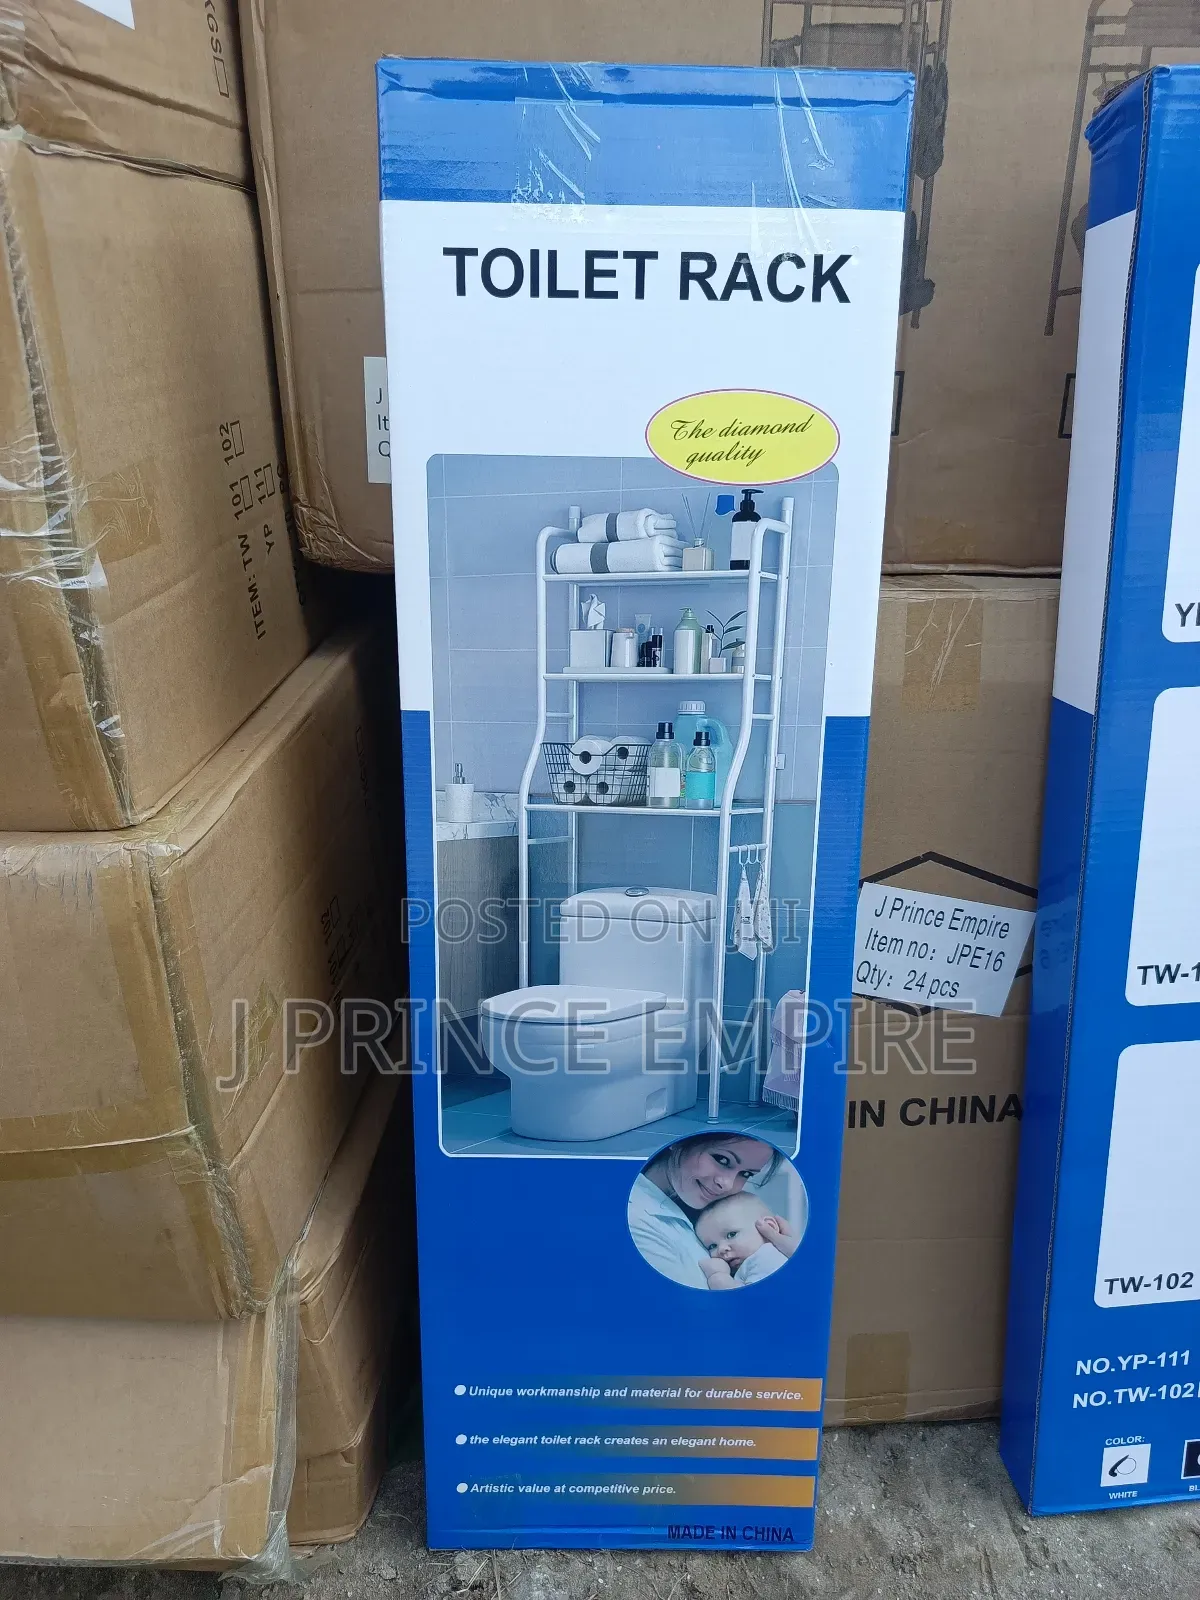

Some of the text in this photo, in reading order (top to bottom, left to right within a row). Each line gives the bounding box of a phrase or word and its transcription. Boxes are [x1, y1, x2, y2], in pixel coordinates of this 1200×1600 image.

[443, 247, 852, 303] TOILET RACK
[670, 414, 815, 442] The diamond
[685, 441, 766, 471] quality
[253, 466, 275, 556] YP 111
[219, 421, 267, 641] ITEM: TW 101 102
[874, 895, 1010, 941] J Prince Empire
[864, 927, 904, 956] Item
[946, 943, 1005, 972] JPE16
[856, 960, 960, 1000] Qty: 24 pcs
[848, 1094, 1024, 1129] IN CHINA
[1103, 1271, 1195, 1295] TW-102
[1075, 1349, 1190, 1376] NO.YP-111
[469, 1386, 804, 1400] Unique workmanship and material for durable service.
[1072, 1380, 1200, 1409] NO.TW-102
[469, 1435, 757, 1448] the elegant toilet rack creates an elegant home.
[1105, 1435, 1146, 1446] COLOR:
[470, 1483, 676, 1496] Artistic value at competitive price.
[1108, 1490, 1138, 1500] WHITE
[667, 1524, 794, 1542] MADE IN CHINA
